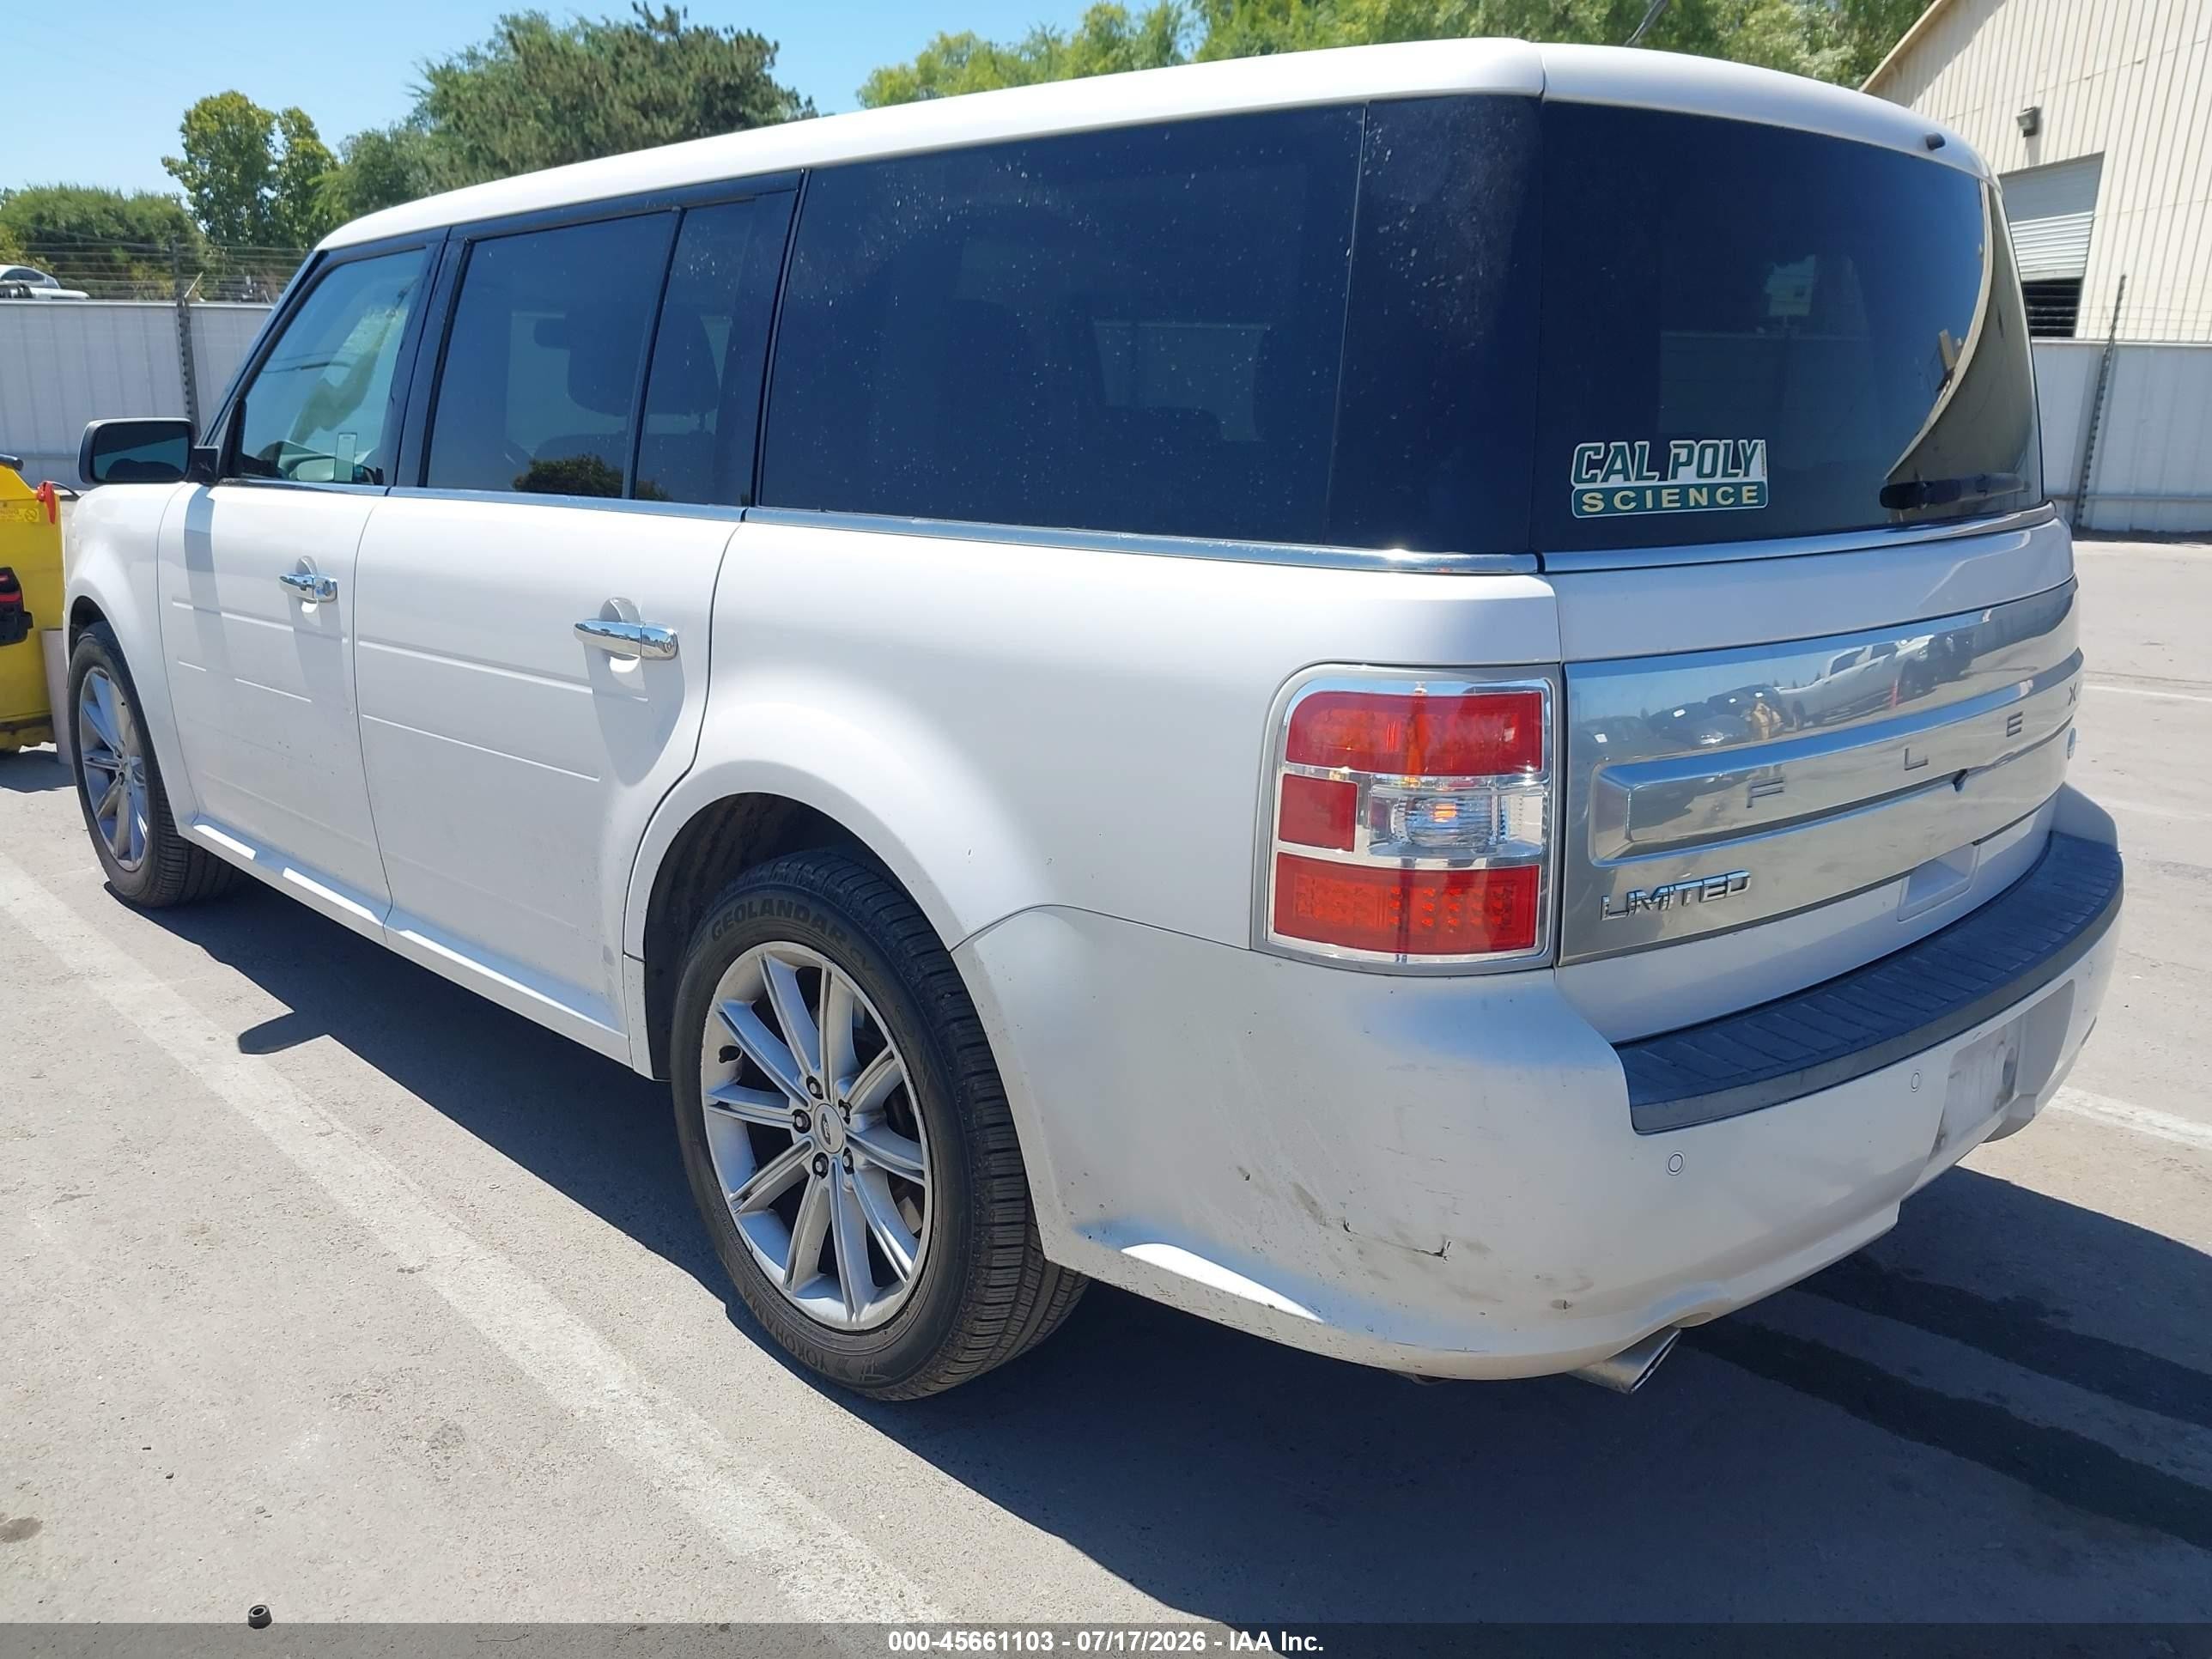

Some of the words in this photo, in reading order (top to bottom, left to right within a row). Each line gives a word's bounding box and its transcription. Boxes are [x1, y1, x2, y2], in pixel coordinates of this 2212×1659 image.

[1571, 442, 1658, 484] CAL
[1669, 440, 1759, 481] POLY
[1582, 485, 1759, 513] SCIENCE
[1601, 870, 1752, 921] LIMITED
[710, 898, 848, 945] GEOLANDAR
